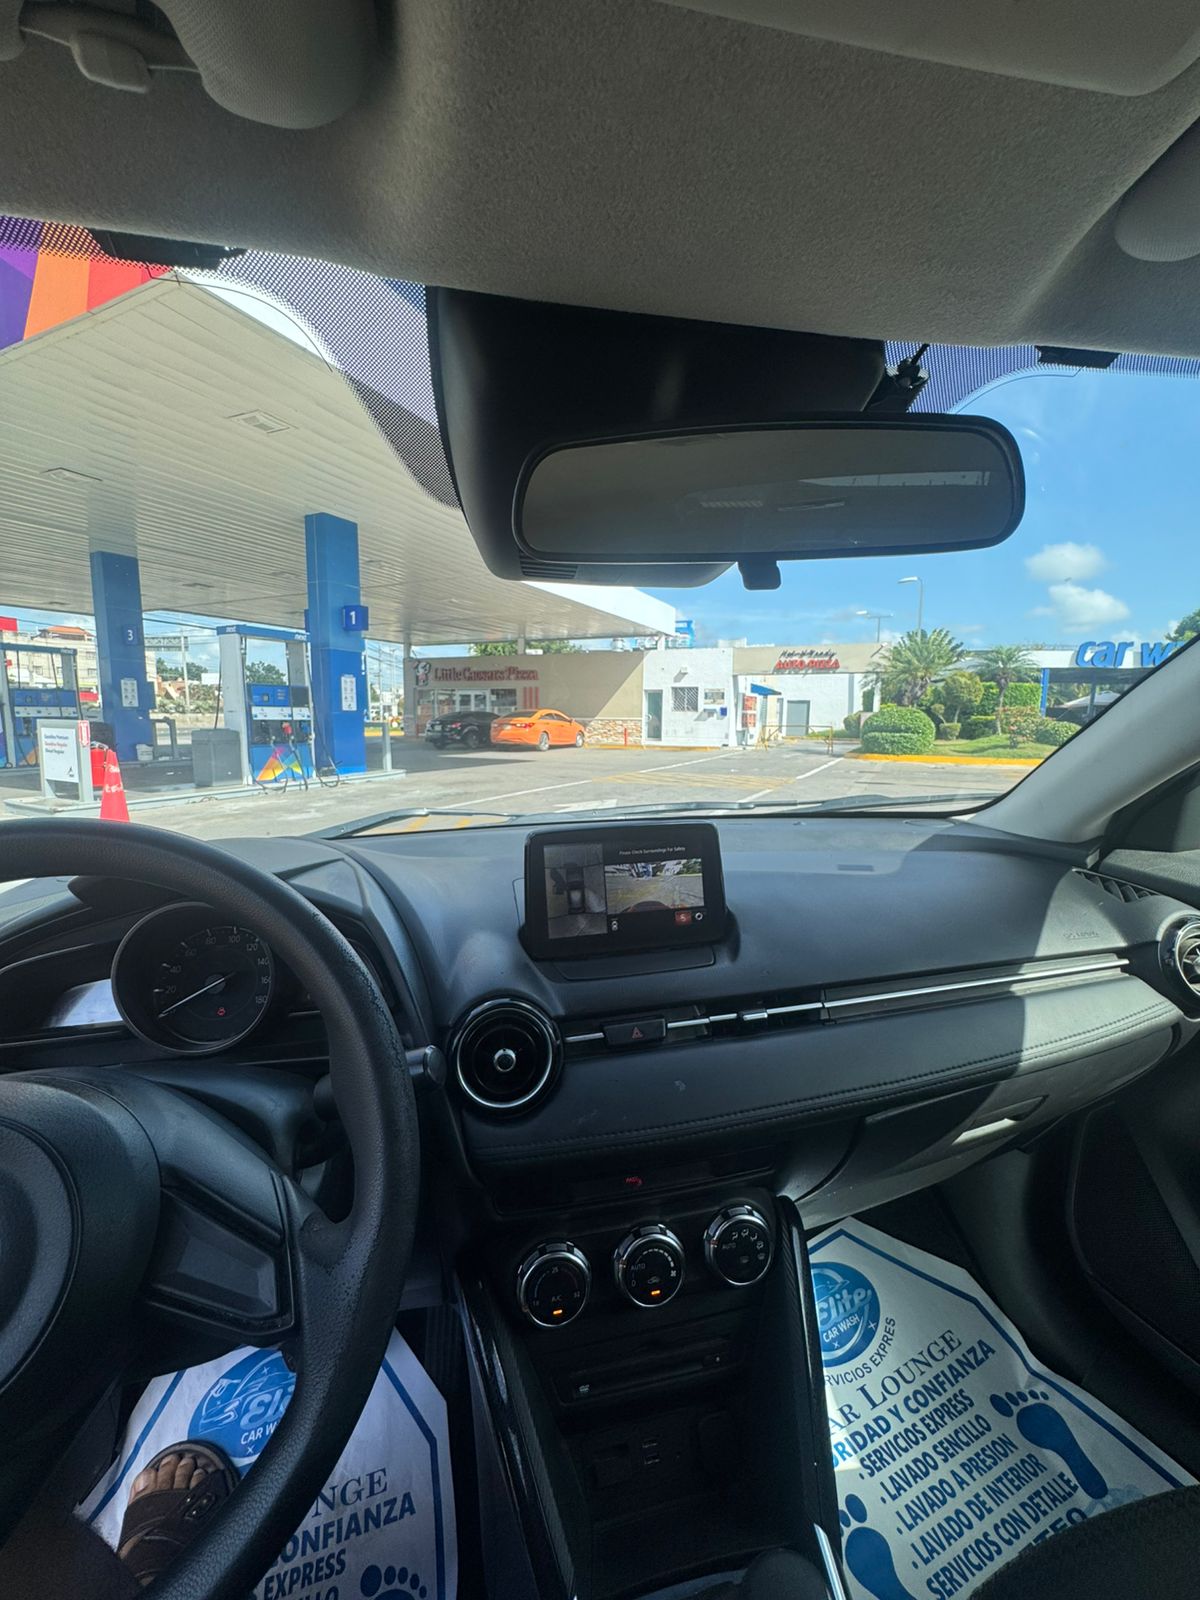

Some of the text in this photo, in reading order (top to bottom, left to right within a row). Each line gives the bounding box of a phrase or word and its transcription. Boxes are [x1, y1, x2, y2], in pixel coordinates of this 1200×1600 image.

[127, 629, 134, 640] 3
[350, 611, 356, 625] 1
[434, 667, 462, 680] Little
[504, 666, 539, 680] Pizza
[1075, 641, 1134, 667] car
[246, 943, 258, 951] 120
[816, 1287, 873, 1321] Elite
[823, 1314, 861, 1343] CAR WASH
[825, 1362, 873, 1386] RVICIOS
[829, 1329, 962, 1435] AR LOUNGE
[240, 1385, 296, 1430] Eli
[832, 1339, 996, 1468] RIDAD Y CONFIANZA
[241, 1427, 264, 1444] CAR
[859, 1388, 975, 1478] SERVICIOS EXPRESS
[880, 1414, 992, 1501] LAVADO SENCILLO
[312, 1468, 388, 1518] NGE
[895, 1433, 1019, 1531] LAVADO A PRESION
[276, 1491, 416, 1565] ONFIANZA
[910, 1508, 974, 1566] LAVADO
[964, 1492, 994, 1522] DE
[982, 1453, 1048, 1507] INTERIOR
[926, 1531, 1003, 1600] SERVICIOS
[993, 1508, 1031, 1546] CON
[1019, 1471, 1079, 1524] DETALLE
[264, 1548, 346, 1600] EXPRESS
